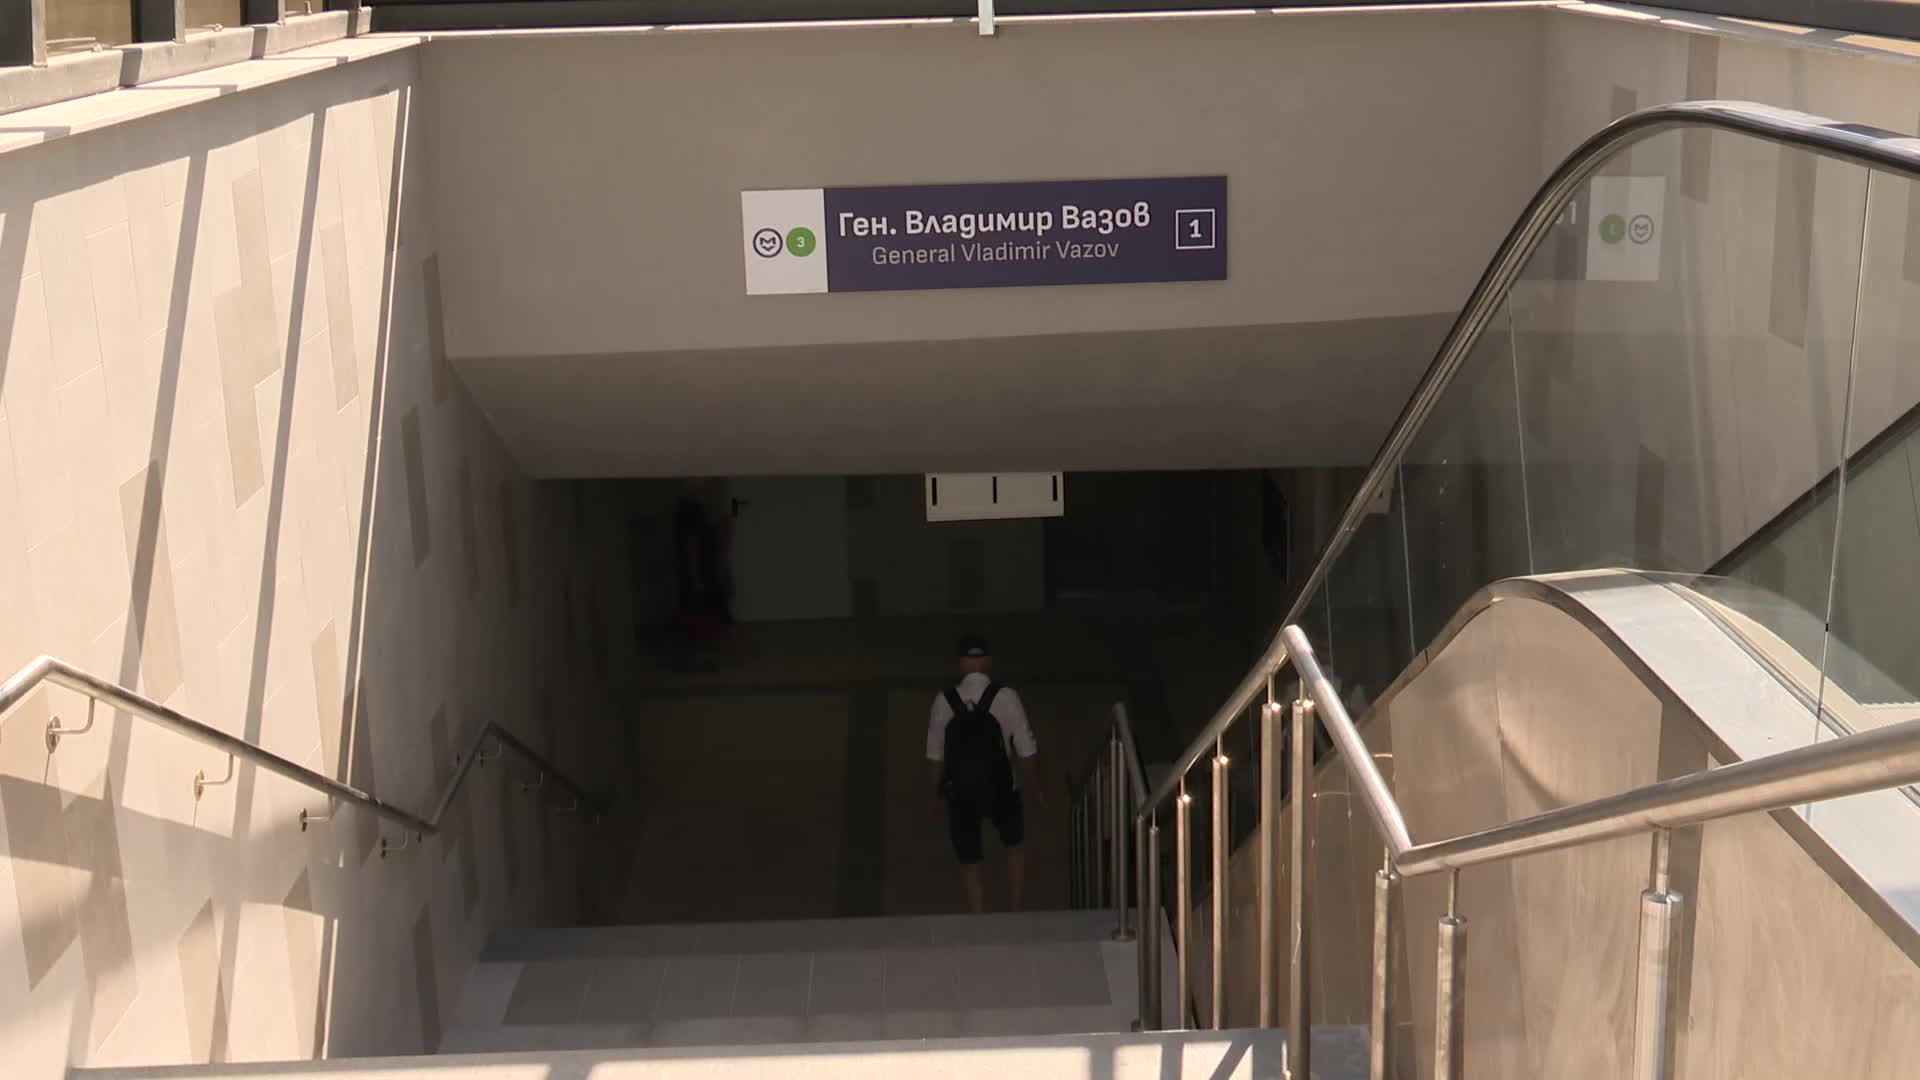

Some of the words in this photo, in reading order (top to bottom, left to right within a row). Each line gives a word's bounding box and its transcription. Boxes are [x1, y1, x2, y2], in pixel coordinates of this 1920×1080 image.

[839, 212, 897, 237] Ген.
[905, 208, 1053, 239] Владимир
[1062, 201, 1150, 235] Вазов
[1189, 219, 1202, 238] 1
[796, 236, 805, 248] 3
[872, 244, 955, 265] General
[961, 241, 1051, 263] Vladimir
[1056, 240, 1119, 260] Vazov
